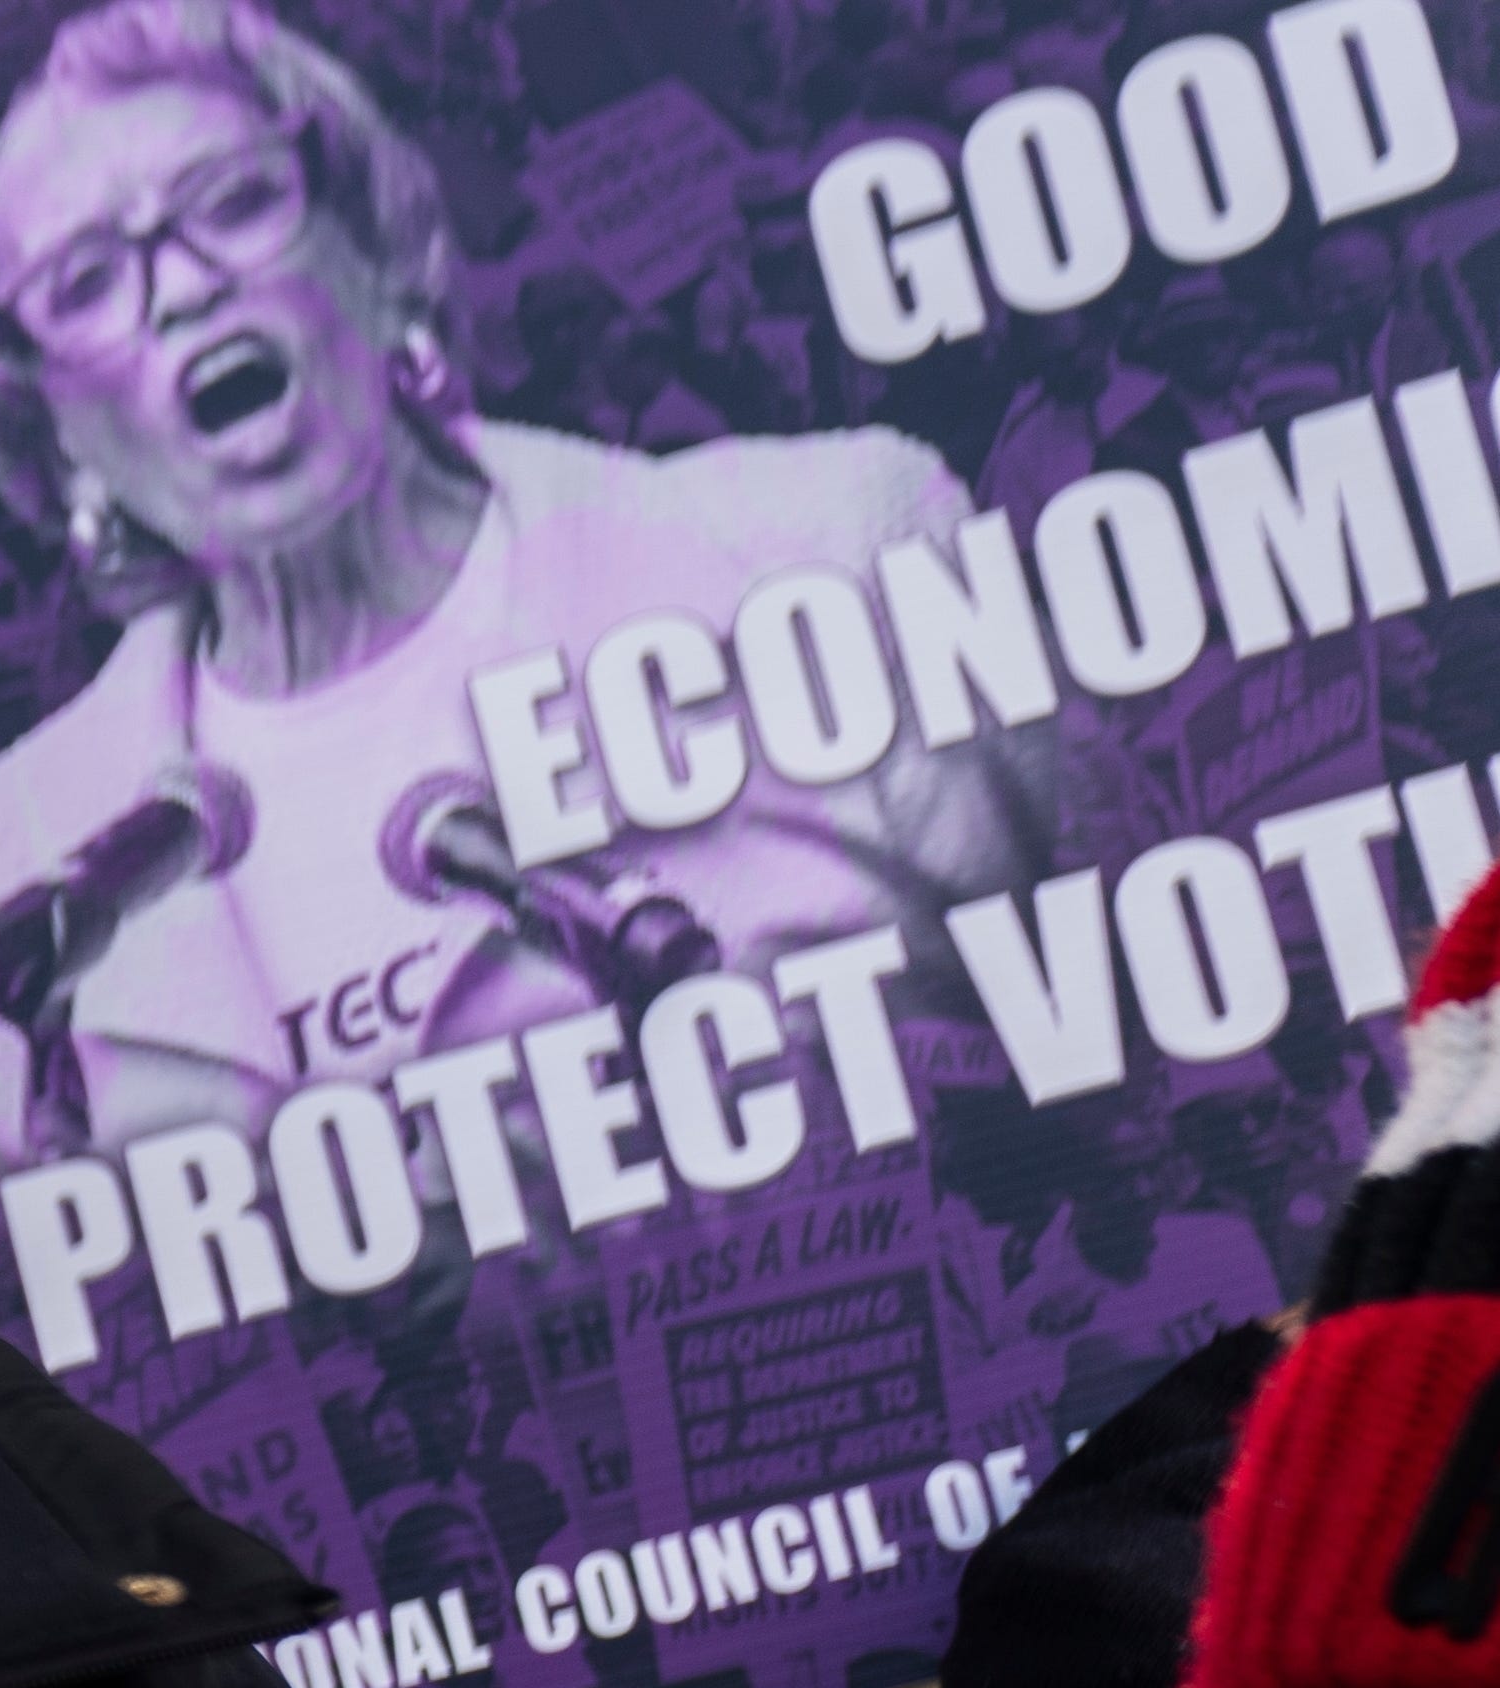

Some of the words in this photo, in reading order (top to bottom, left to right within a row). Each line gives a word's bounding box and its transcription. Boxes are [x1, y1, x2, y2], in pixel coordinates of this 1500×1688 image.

[808, 0, 1460, 364] GOOD
[468, 365, 1500, 870] ECONOMI
[0, 922, 917, 1374] PROTECT
[945, 752, 1500, 1106] VOTI
[624, 1234, 743, 1338] PASS
[753, 1218, 784, 1280] A
[515, 1482, 901, 1655] COUNCIL
[923, 1443, 1034, 1552] OF
